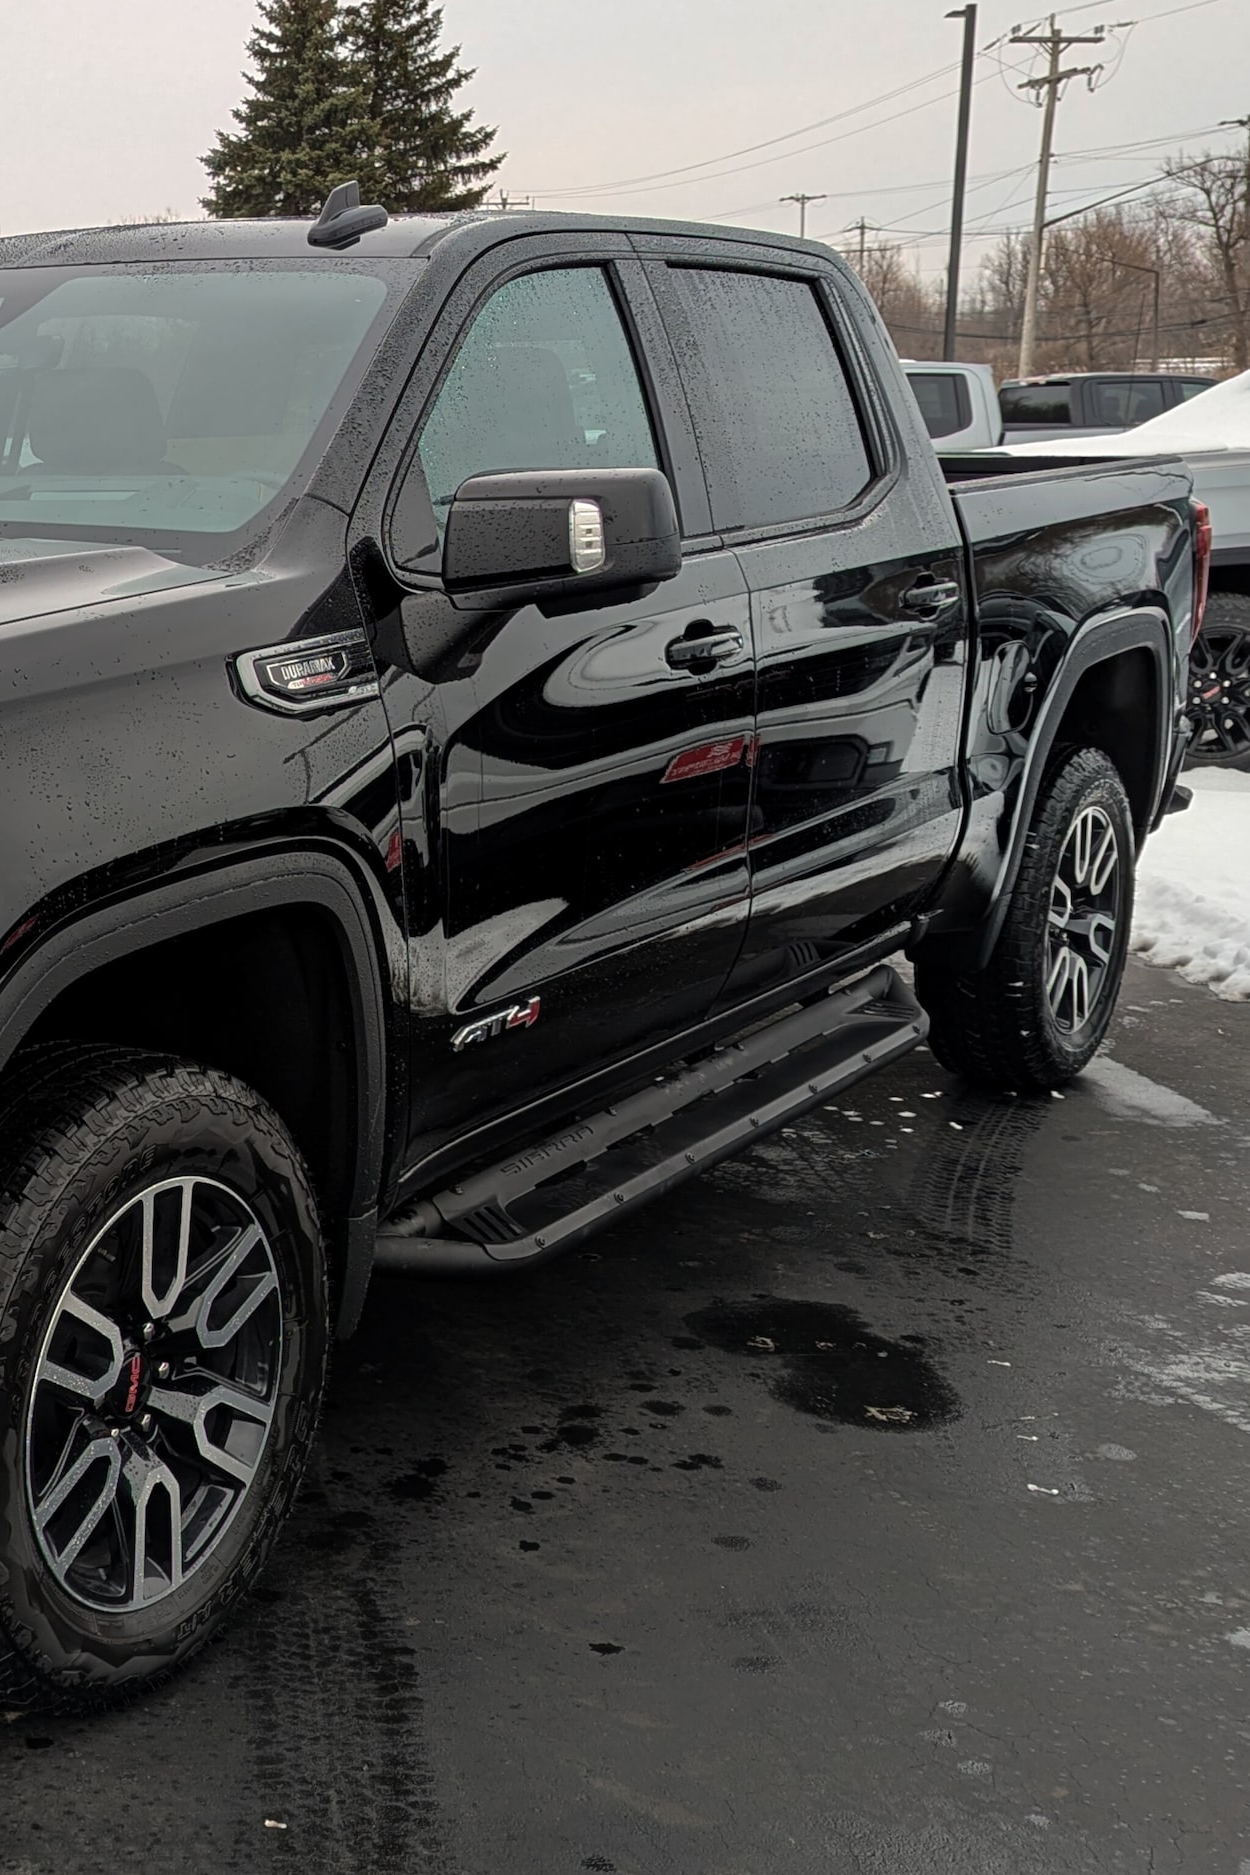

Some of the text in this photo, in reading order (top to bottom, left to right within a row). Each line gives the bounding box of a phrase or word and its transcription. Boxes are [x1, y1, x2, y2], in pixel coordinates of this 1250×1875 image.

[451, 996, 541, 1052] AT4
[500, 1125, 594, 1177] SIERRA
[125, 1353, 142, 1413] GMC
